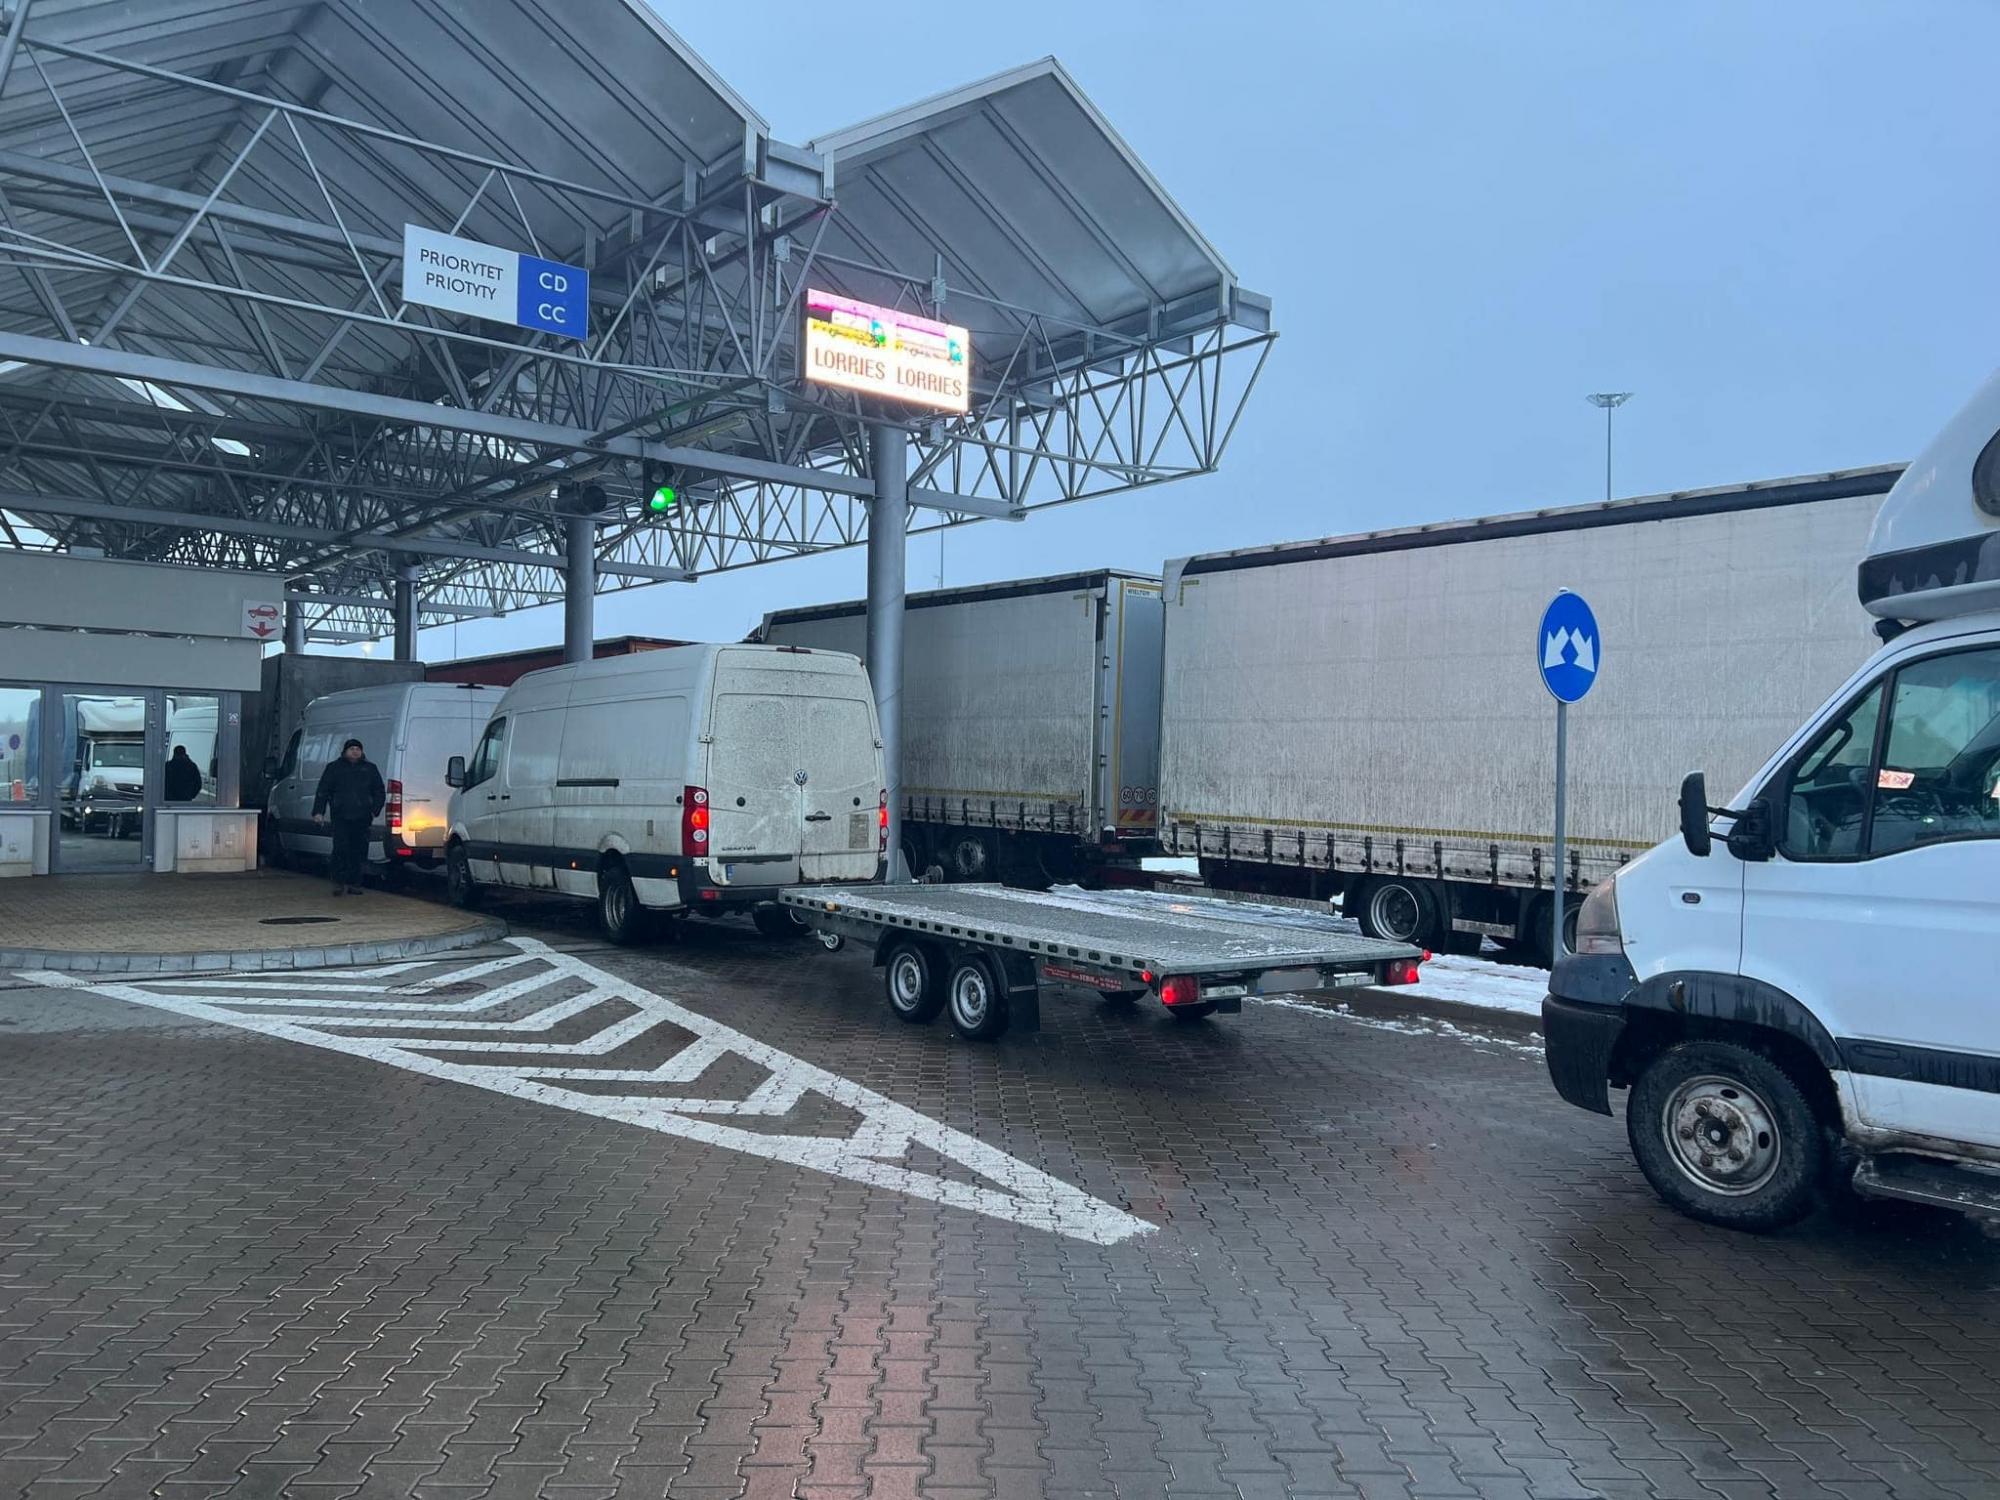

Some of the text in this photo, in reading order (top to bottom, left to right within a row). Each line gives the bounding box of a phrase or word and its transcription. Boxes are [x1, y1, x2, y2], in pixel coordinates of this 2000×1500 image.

[420, 249, 503, 280] PRIORYTET
[426, 272, 496, 300] PRIOTYTY
[538, 272, 568, 293] CD
[537, 303, 567, 324] CC
[814, 347, 886, 381] LORRIES
[896, 366, 963, 398] LORRIES
